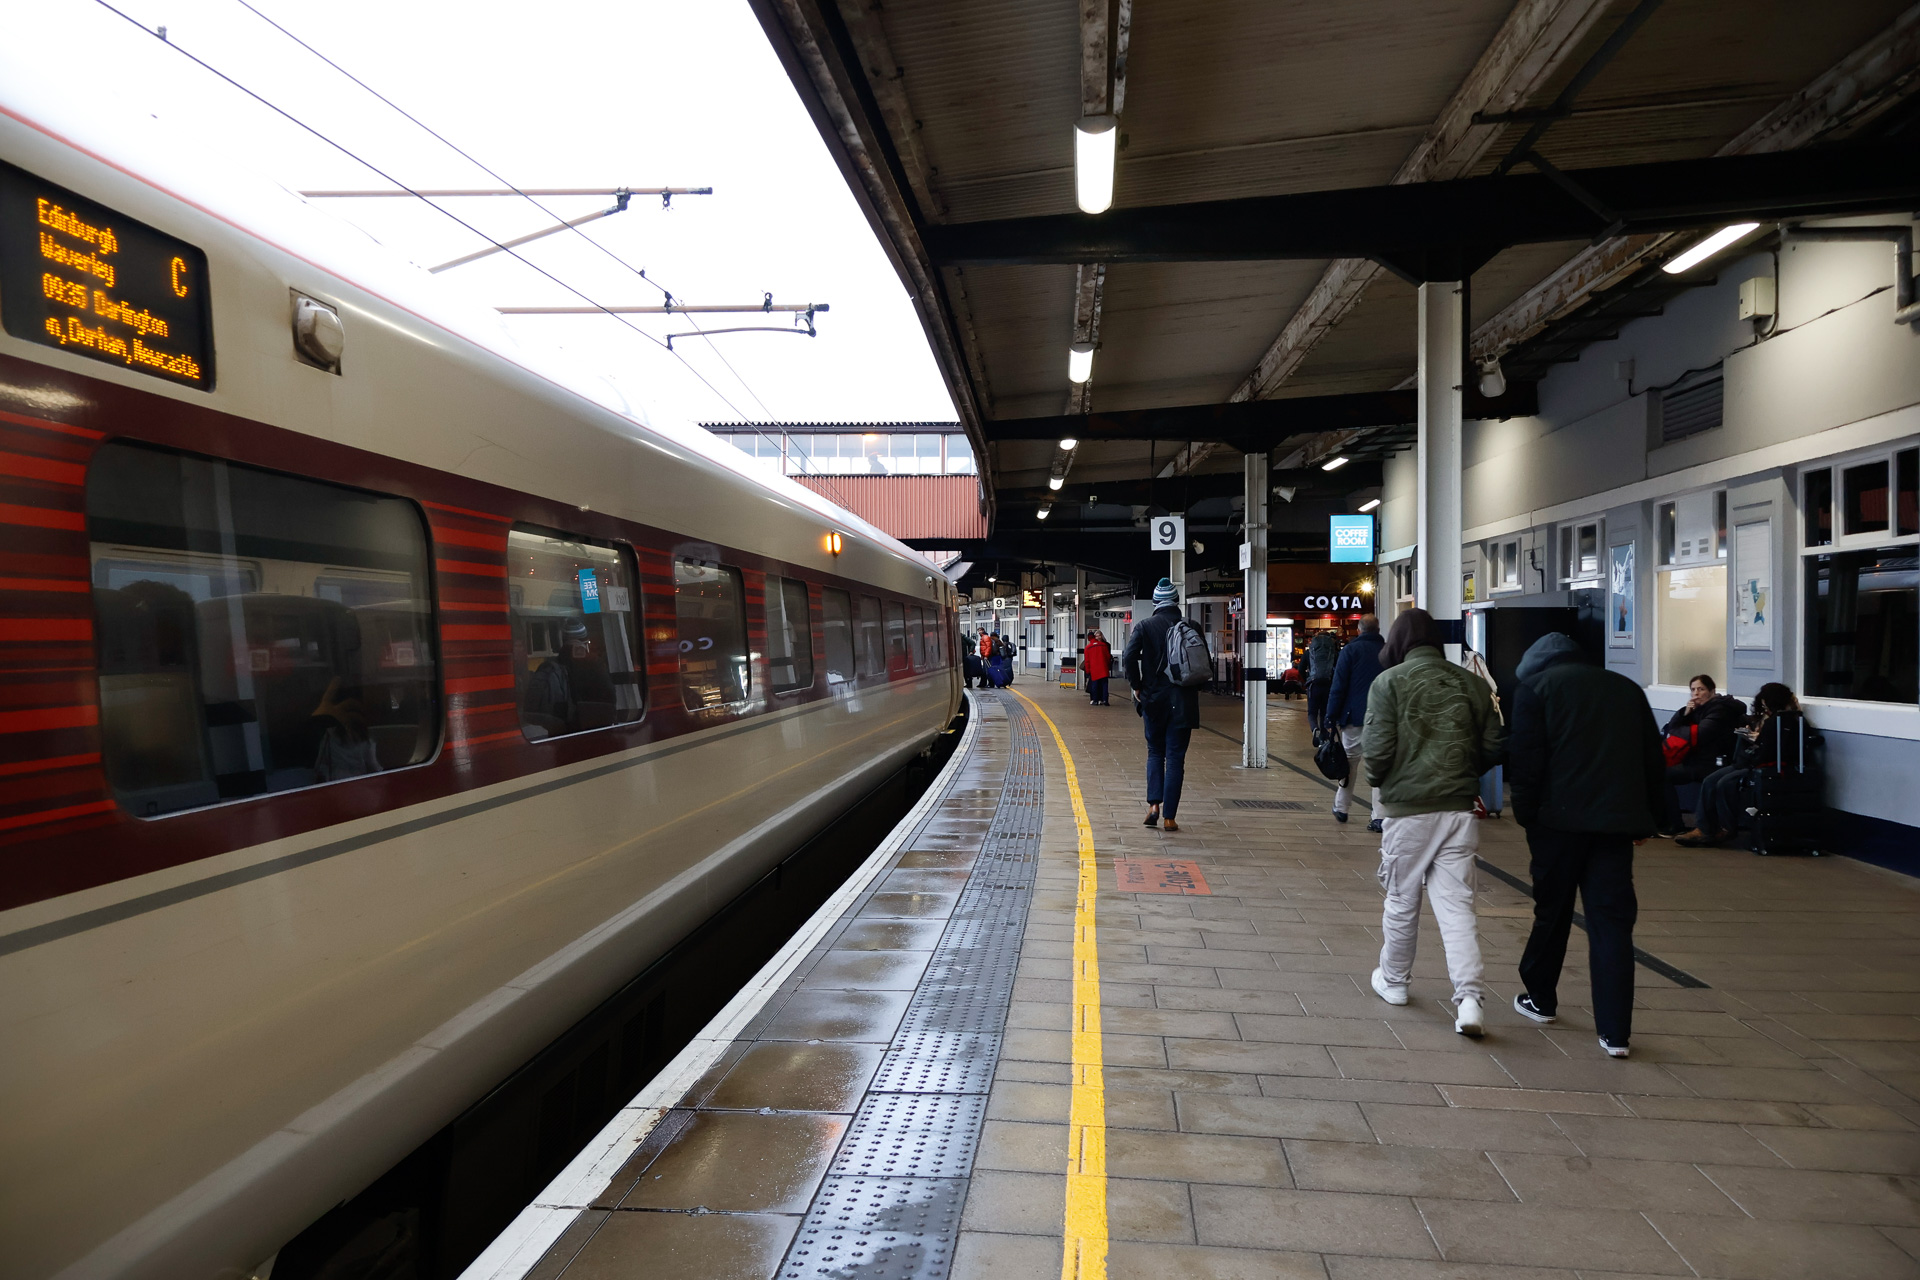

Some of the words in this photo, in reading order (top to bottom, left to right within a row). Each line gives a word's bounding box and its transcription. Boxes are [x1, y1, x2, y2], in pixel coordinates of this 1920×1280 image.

[37, 197, 119, 255] Edinburgh
[40, 231, 115, 288] Waverley
[171, 256, 188, 297] C
[93, 289, 169, 338] Darlington
[1158, 521, 1177, 546] 9
[1335, 529, 1368, 537] COFFEE
[1337, 537, 1366, 545] ROOM
[996, 599, 1003, 608] 9
[1304, 596, 1362, 611] COSTA
